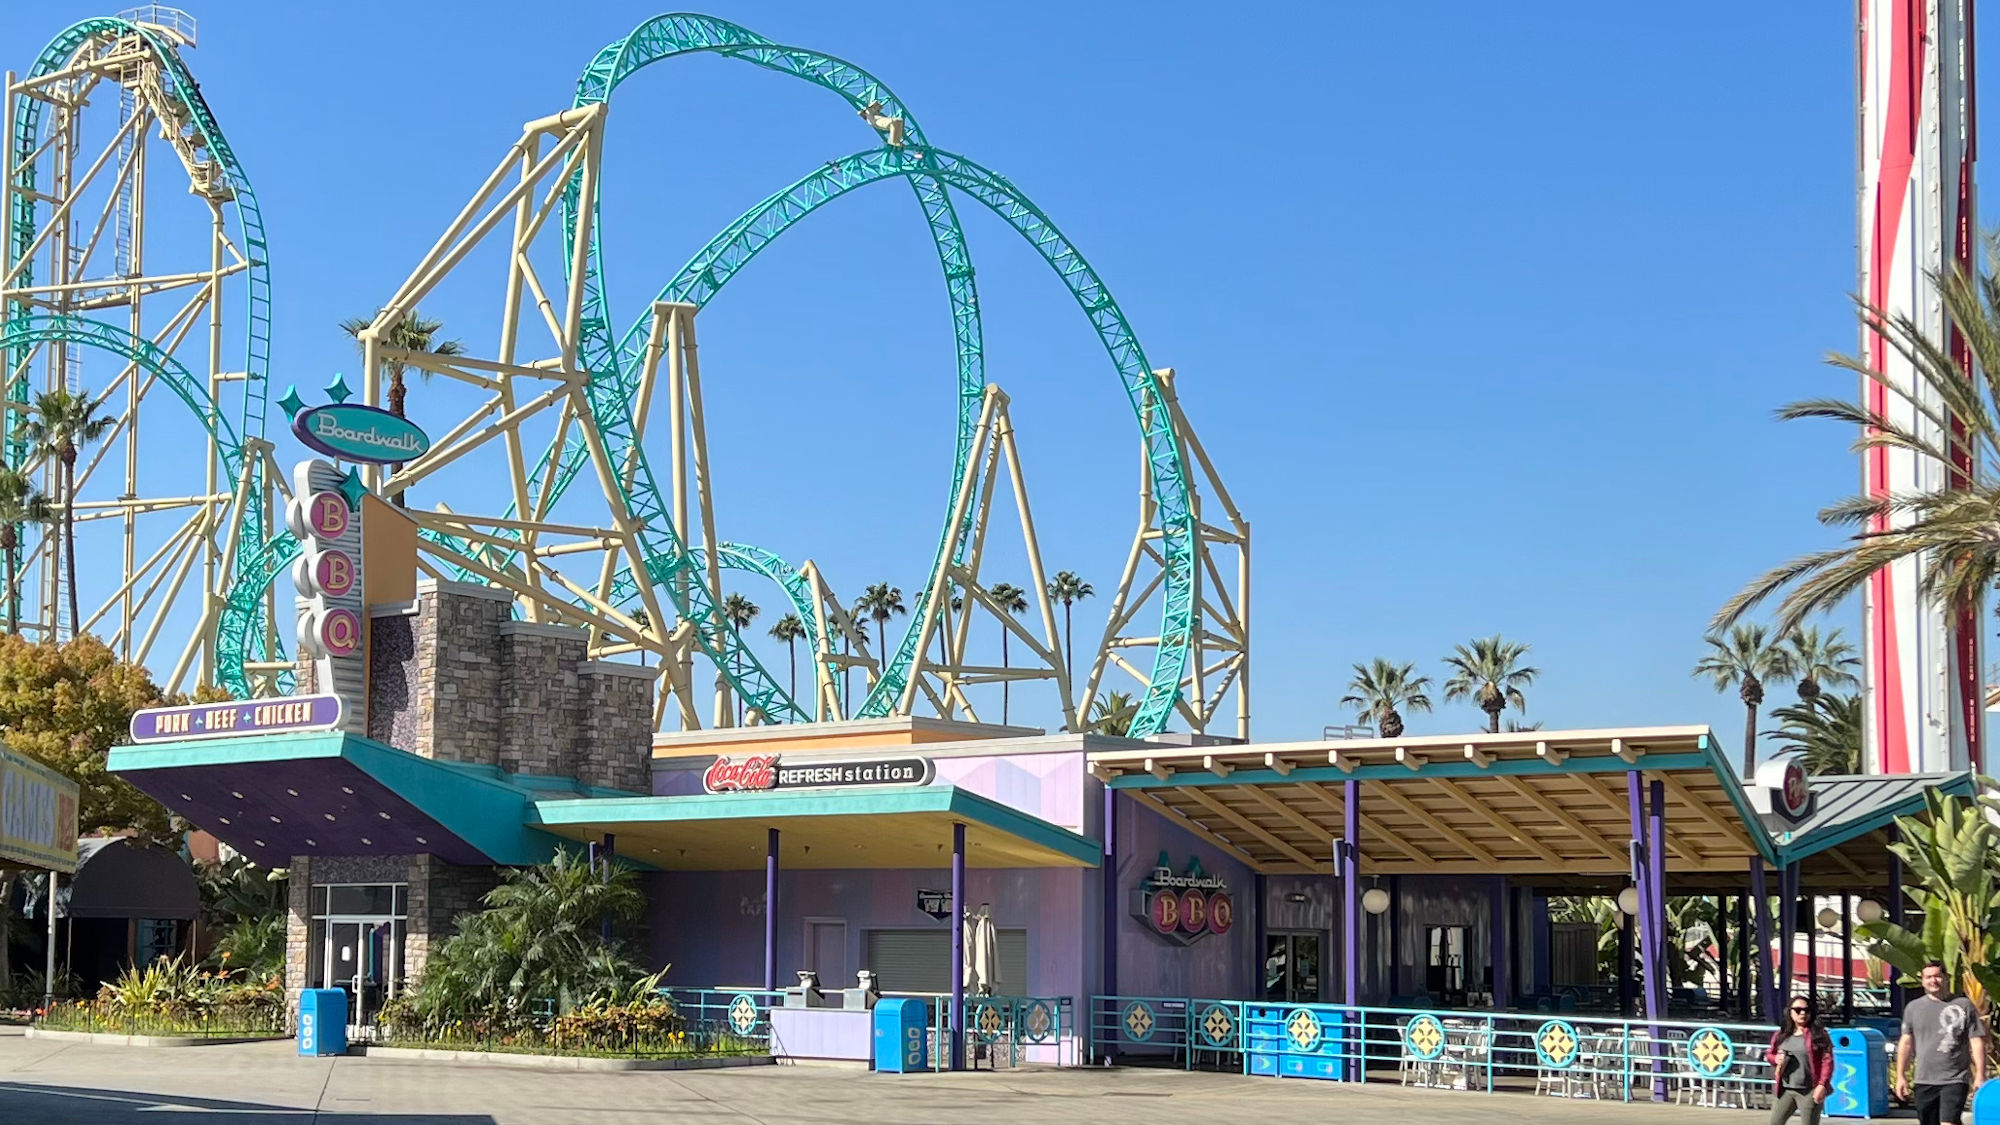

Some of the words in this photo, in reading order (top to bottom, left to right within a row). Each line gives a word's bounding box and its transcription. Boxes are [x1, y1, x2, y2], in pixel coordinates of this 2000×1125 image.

[316, 412, 423, 453] Boardwalk
[319, 497, 356, 649] BBQ
[155, 713, 191, 734] PORK
[205, 708, 238, 730] BEEF
[254, 702, 313, 726] CHICKEN
[708, 755, 774, 790] Coca-Cola
[779, 766, 843, 784] REFRESH
[845, 764, 915, 781] station
[1149, 866, 1227, 888] Boardwalk
[1160, 895, 1232, 927] BBQ
